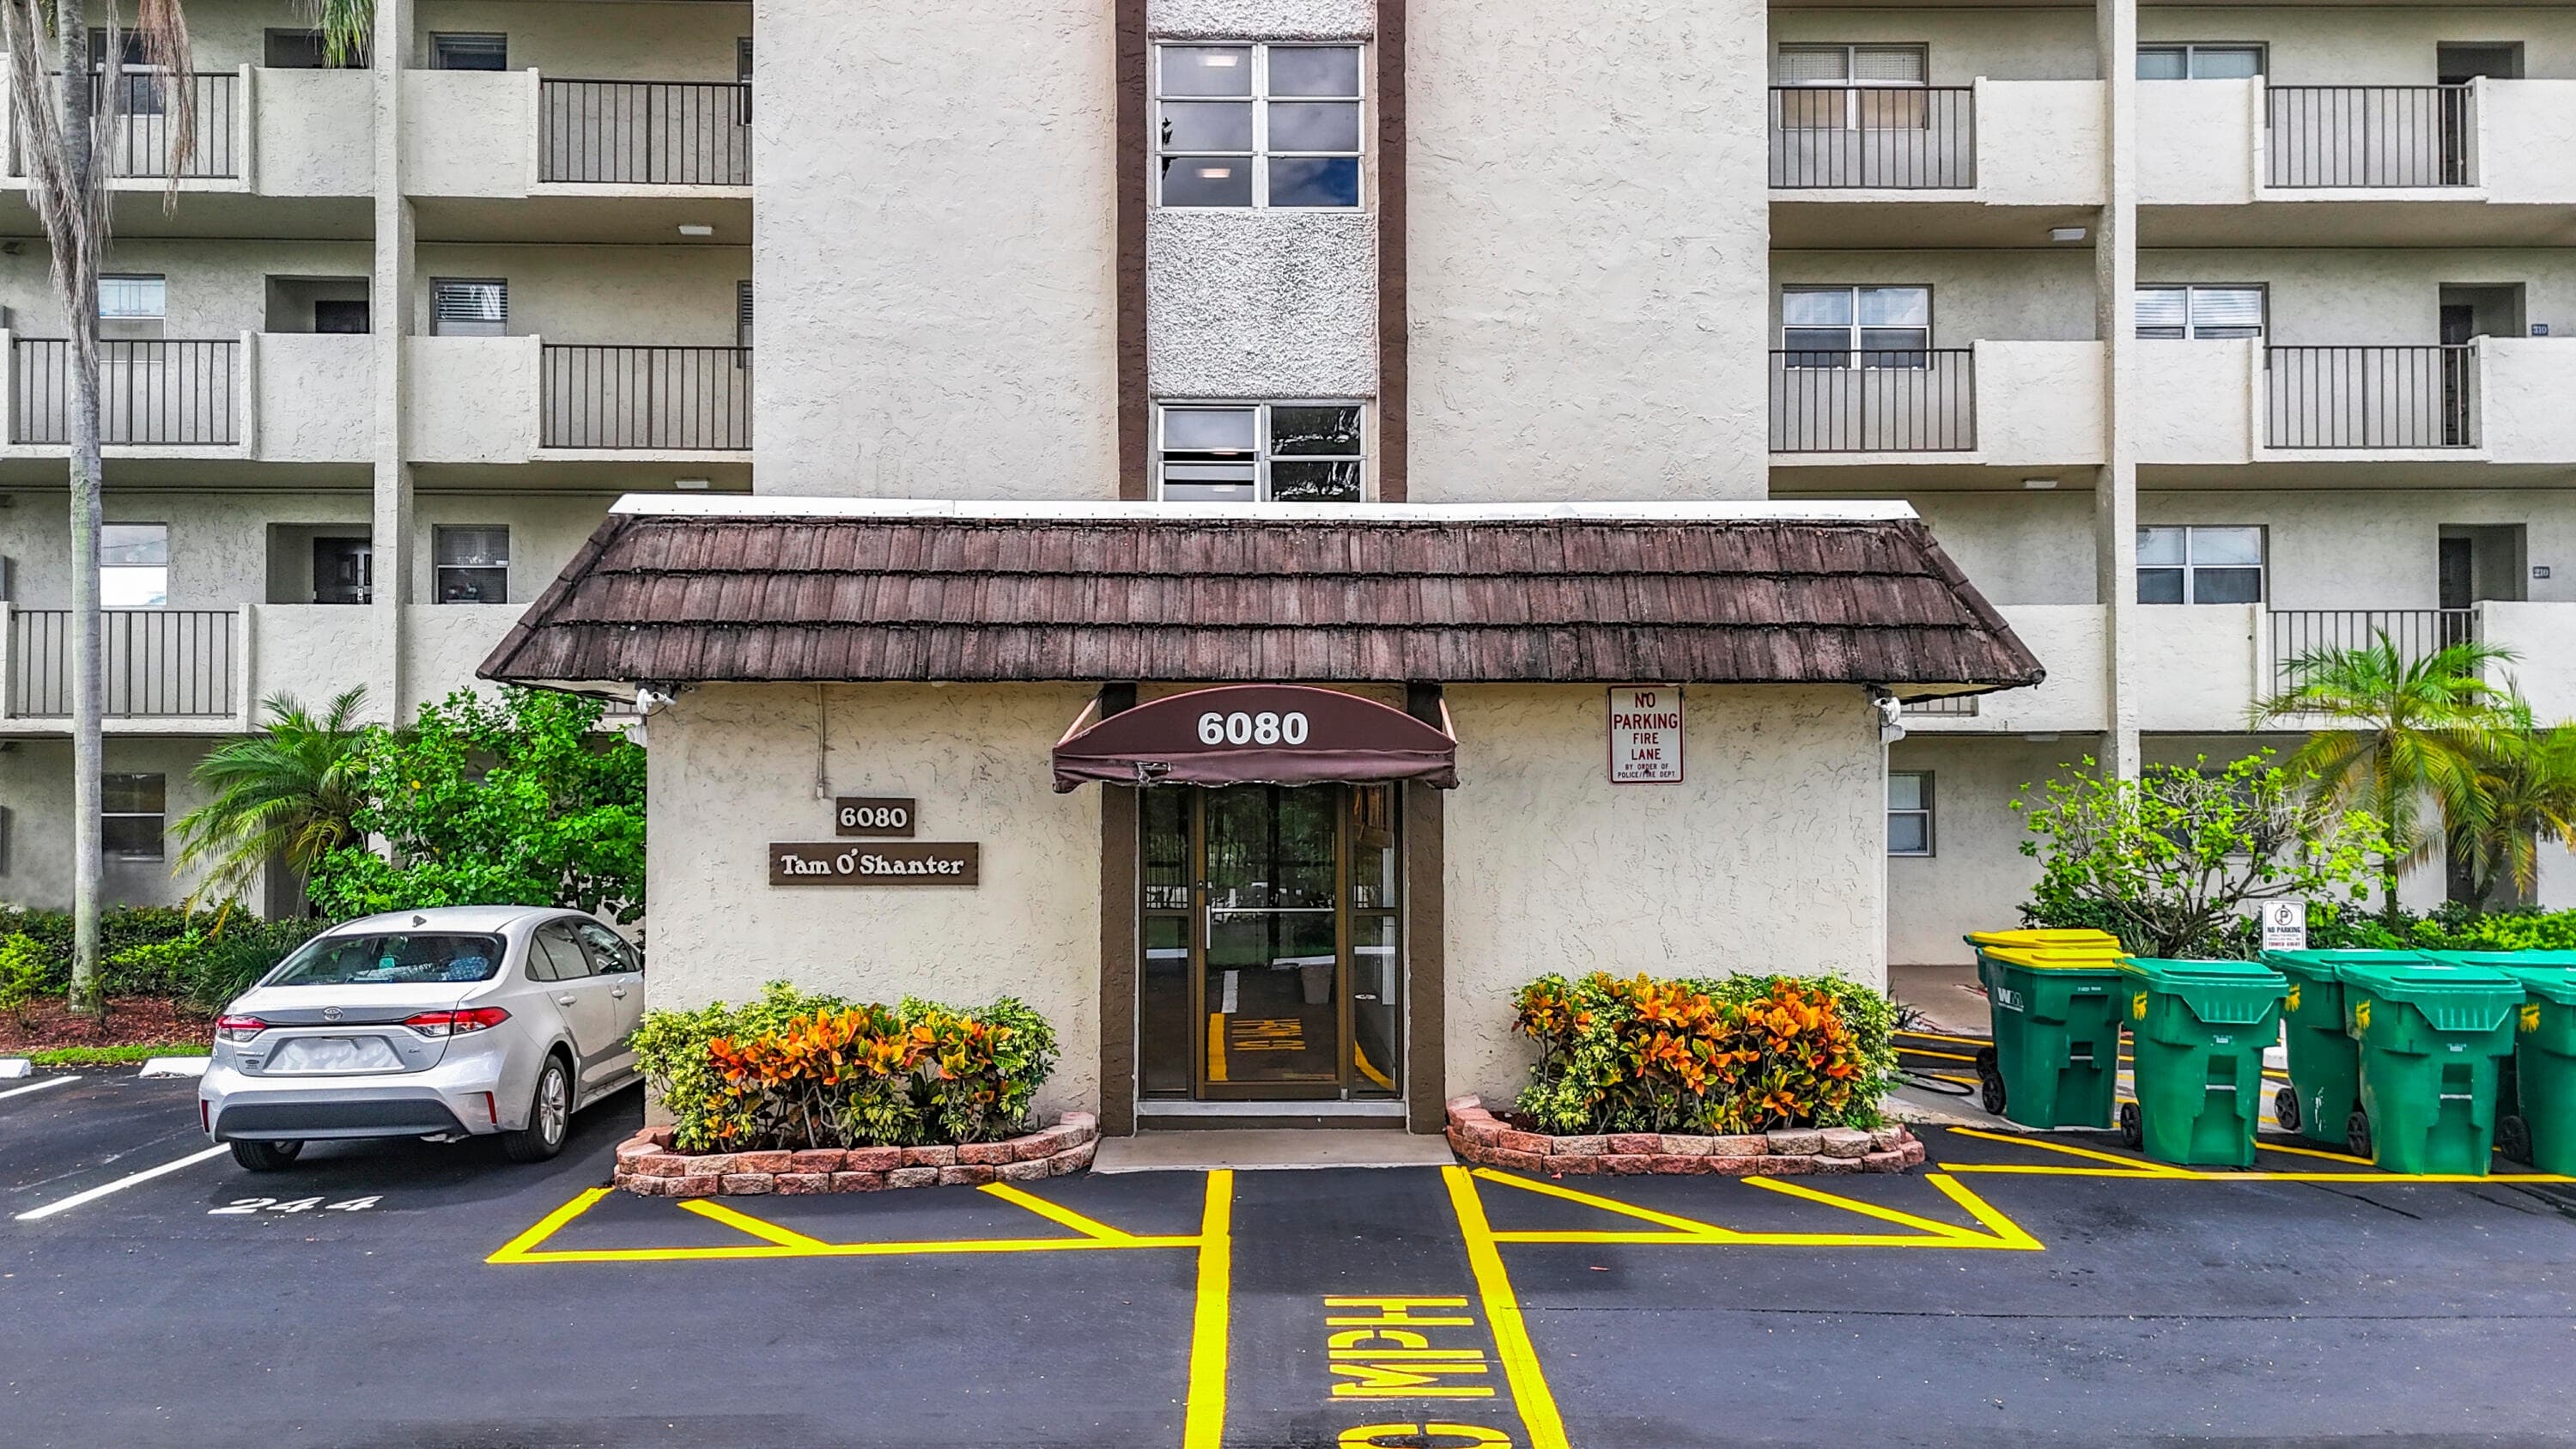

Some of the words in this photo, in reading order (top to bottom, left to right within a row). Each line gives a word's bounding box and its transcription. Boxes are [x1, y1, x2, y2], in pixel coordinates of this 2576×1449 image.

[2532, 326, 2548, 334] 310
[1635, 692, 1656, 708] NO
[1198, 711, 1309, 745] 6080
[1613, 713, 1678, 730] PARKING
[1633, 733, 1659, 745] FIRE
[1631, 748, 1662, 761] LANE
[840, 807, 908, 828] 6080
[781, 855, 832, 875] Tam
[207, 1195, 384, 1215] 244
[1324, 1297, 1495, 1397] MPH
